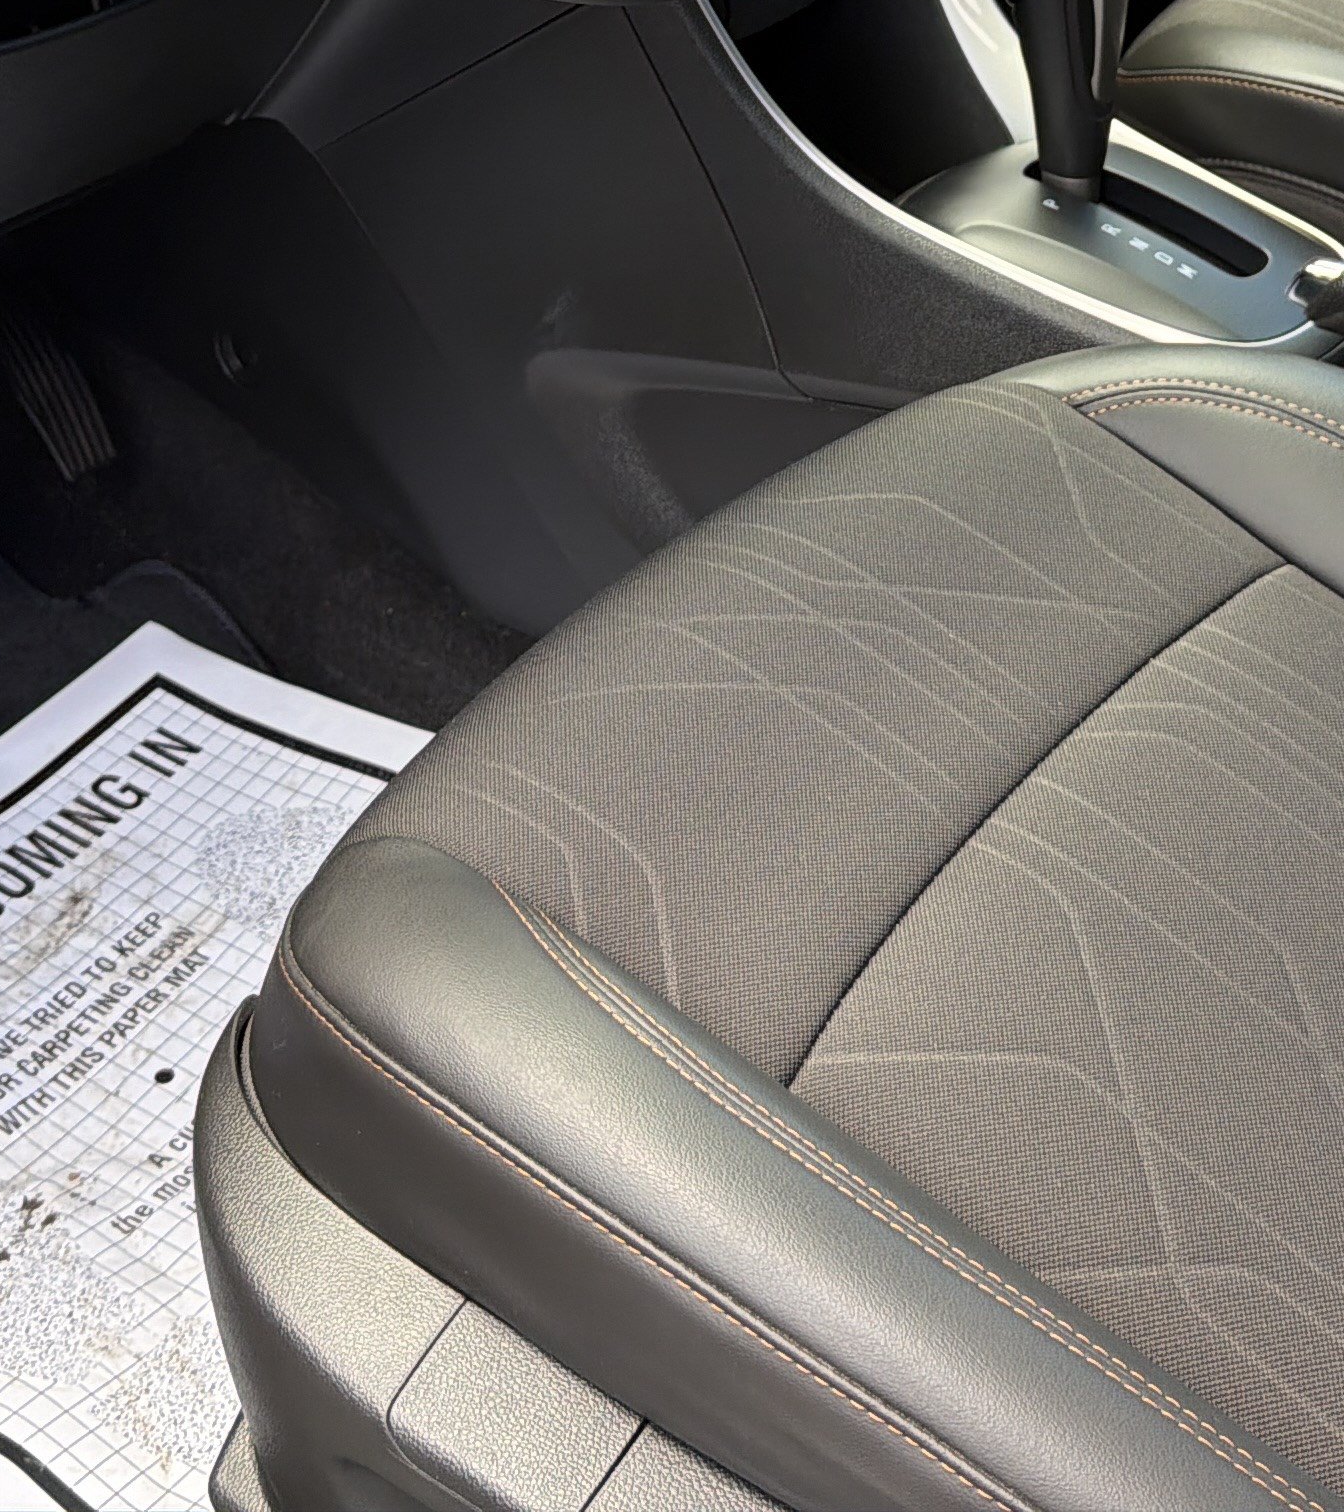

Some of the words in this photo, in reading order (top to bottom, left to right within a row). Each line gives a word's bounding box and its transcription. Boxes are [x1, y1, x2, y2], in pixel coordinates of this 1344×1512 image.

[1042, 198, 1060, 211] P
[1100, 223, 1122, 237] R
[1154, 251, 1174, 266] D
[129, 726, 204, 780] IN
[22, 980, 87, 1035] TRIED
[81, 956, 117, 981] TO
[112, 911, 165, 959] KEEP
[16, 979, 132, 1078] CARPETING
[128, 924, 196, 981] CLEAN
[49, 1046, 104, 1091] THIS
[99, 987, 167, 1049] PAPER
[165, 947, 210, 991] MAT
[148, 1153, 174, 1168] A
[111, 1204, 154, 1235] the
